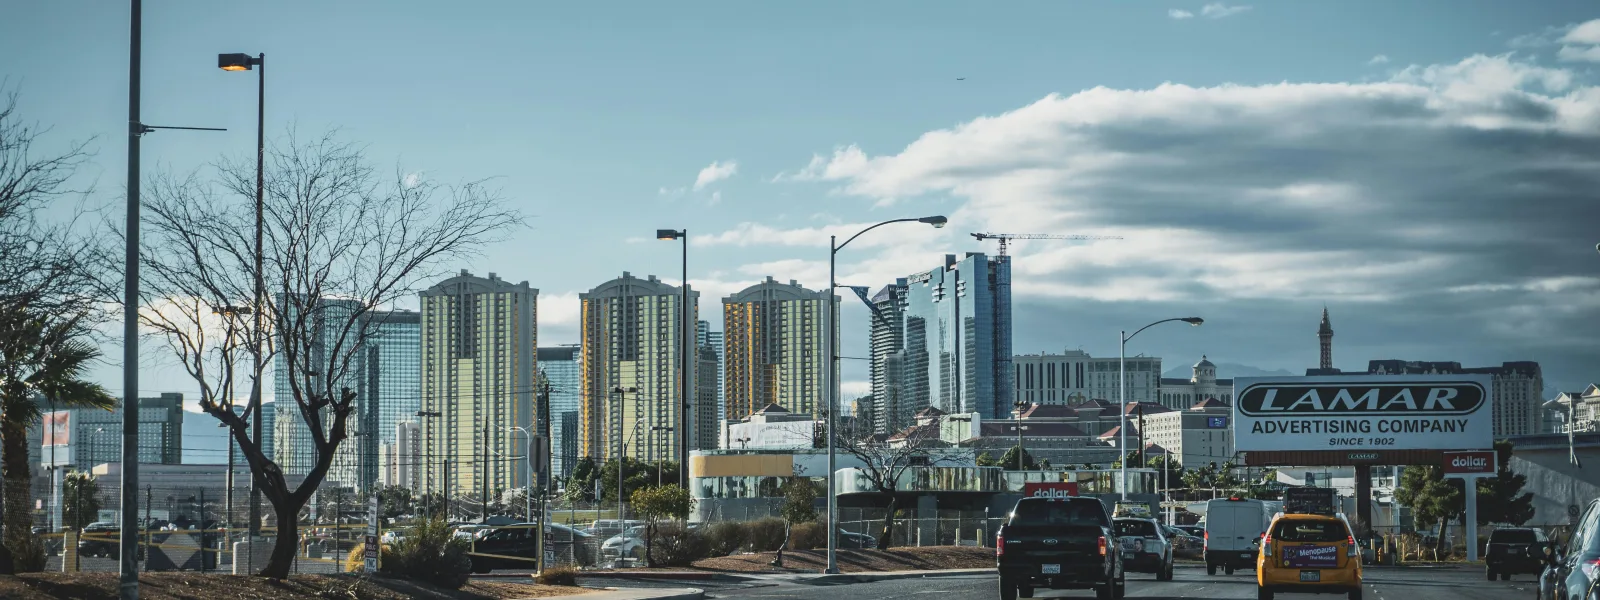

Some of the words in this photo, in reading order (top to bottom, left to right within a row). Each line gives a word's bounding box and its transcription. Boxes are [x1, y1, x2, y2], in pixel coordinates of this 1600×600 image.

[1260, 388, 1459, 411] LAMAR
[1251, 419, 1371, 434] ADVERTISING
[1377, 419, 1469, 434] COMPANY
[1328, 438, 1363, 446] SINCE
[1368, 437, 1395, 445] 1902
[1299, 546, 1336, 557] Menopause
